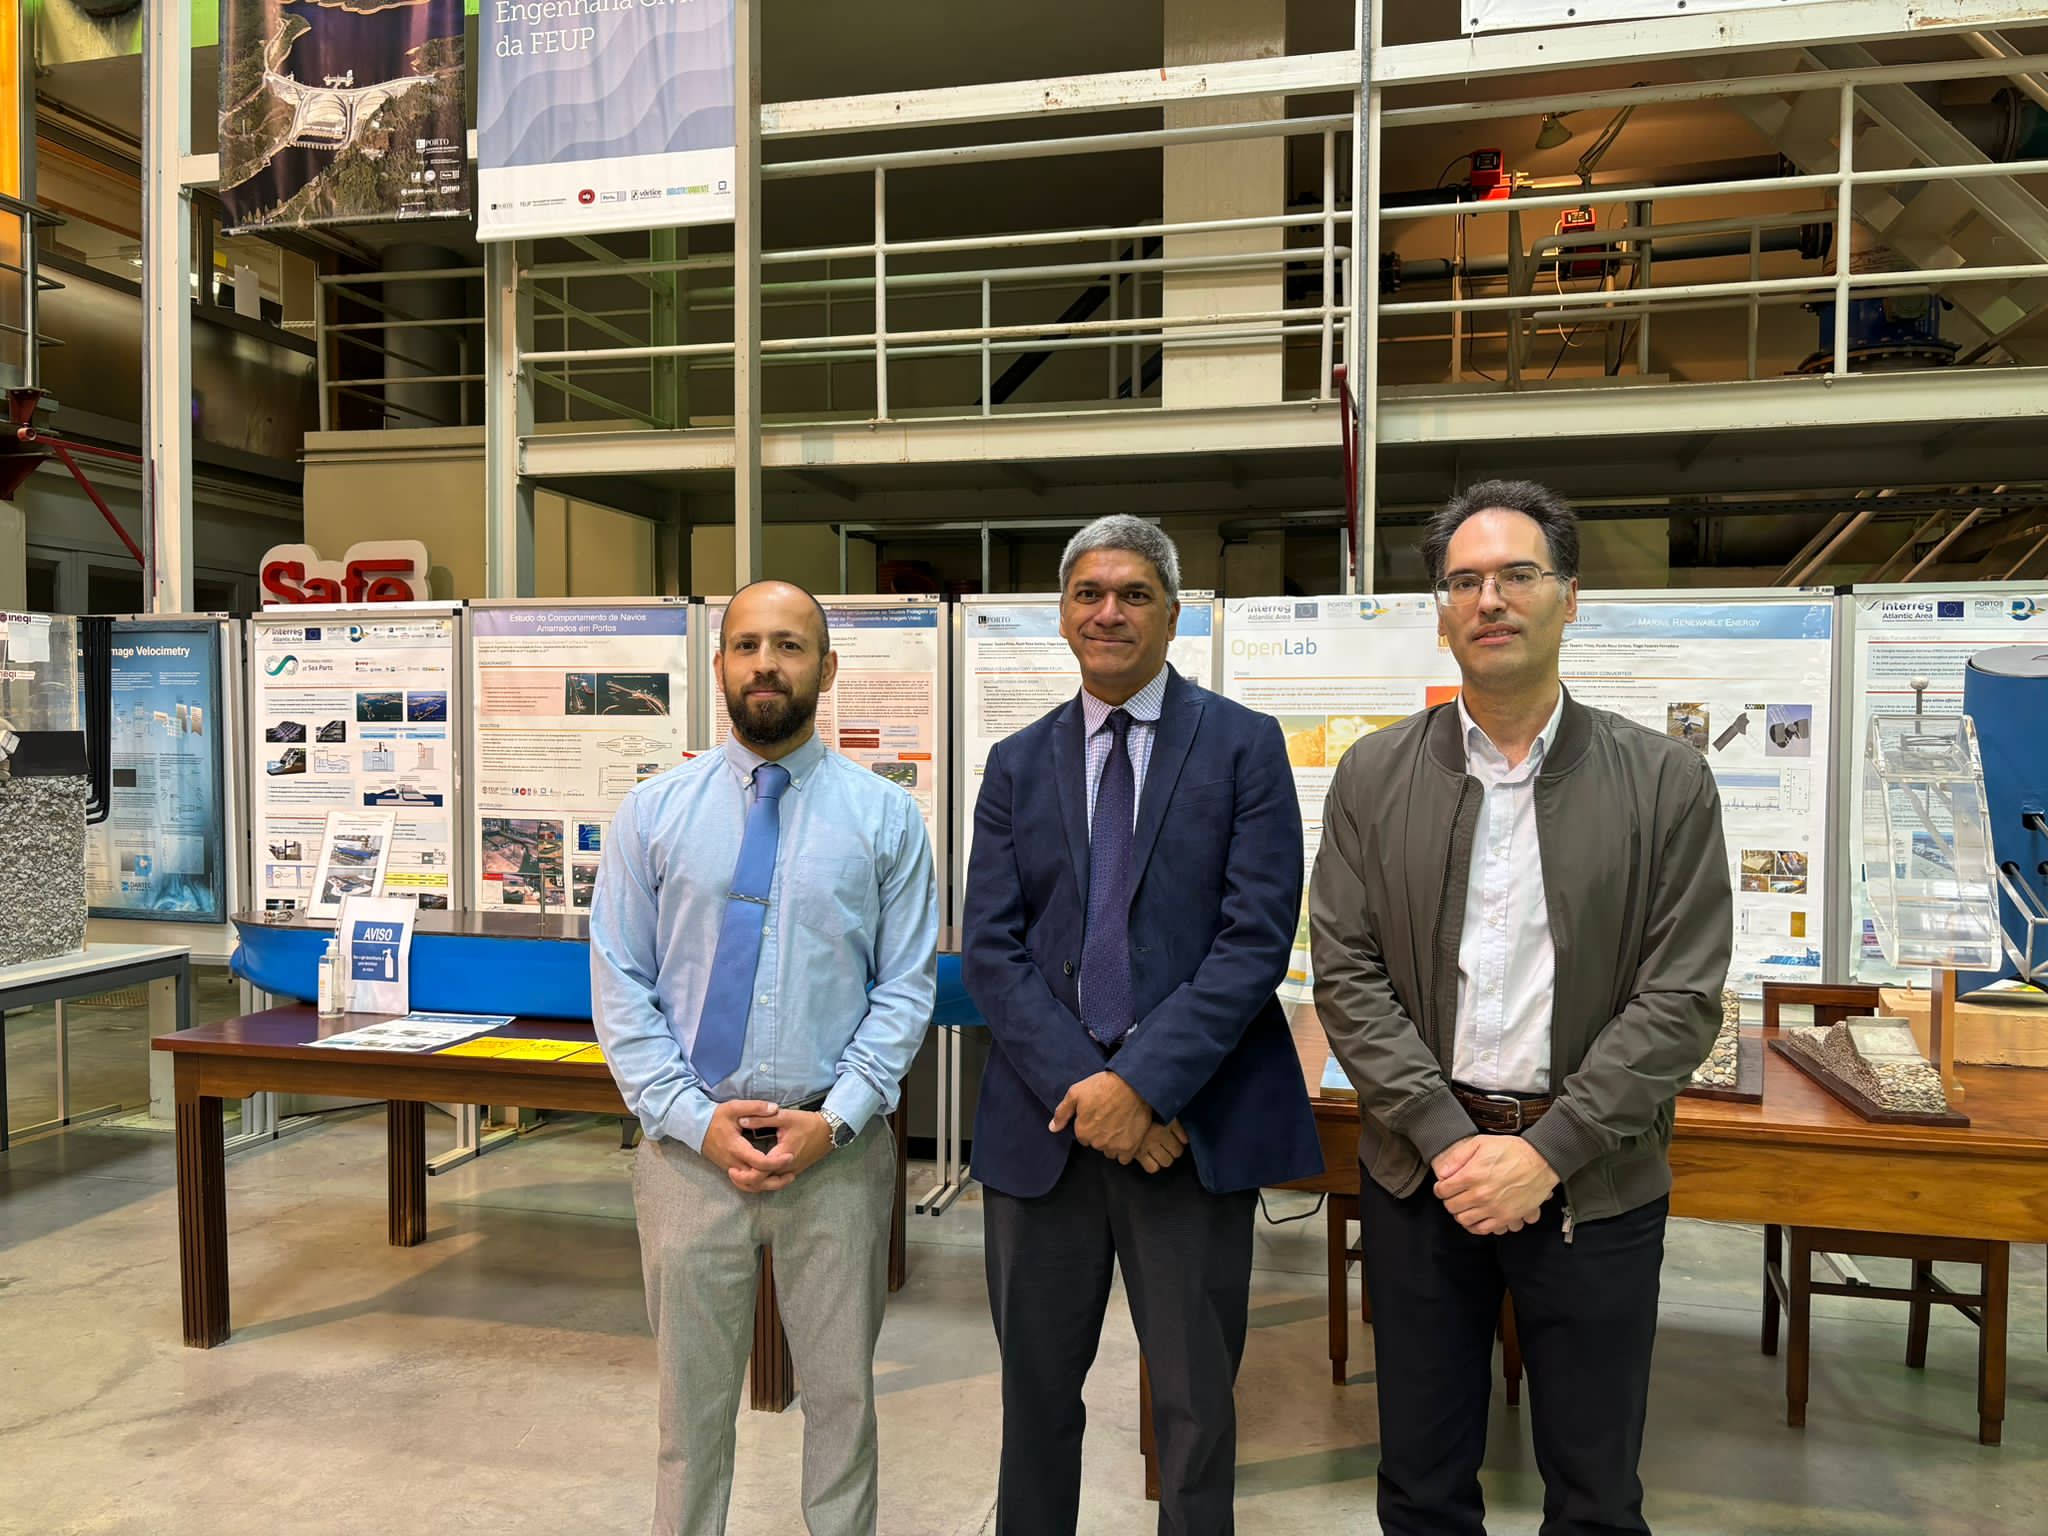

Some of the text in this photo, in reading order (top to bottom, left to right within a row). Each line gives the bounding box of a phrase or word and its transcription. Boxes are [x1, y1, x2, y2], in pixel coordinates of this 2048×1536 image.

[496, 0, 633, 25] Engenharia
[495, 28, 595, 57] da FEUP
[262, 559, 415, 605] Safe
[1882, 600, 1933, 612] Interreg
[510, 614, 535, 622] Estudo
[548, 614, 607, 623] Comportamento
[620, 613, 647, 622] Navios
[592, 624, 617, 632] Portos
[111, 645, 191, 658] mage Velocimetry
[1231, 637, 1317, 660] OpenLab
[363, 928, 393, 942] AVISO
